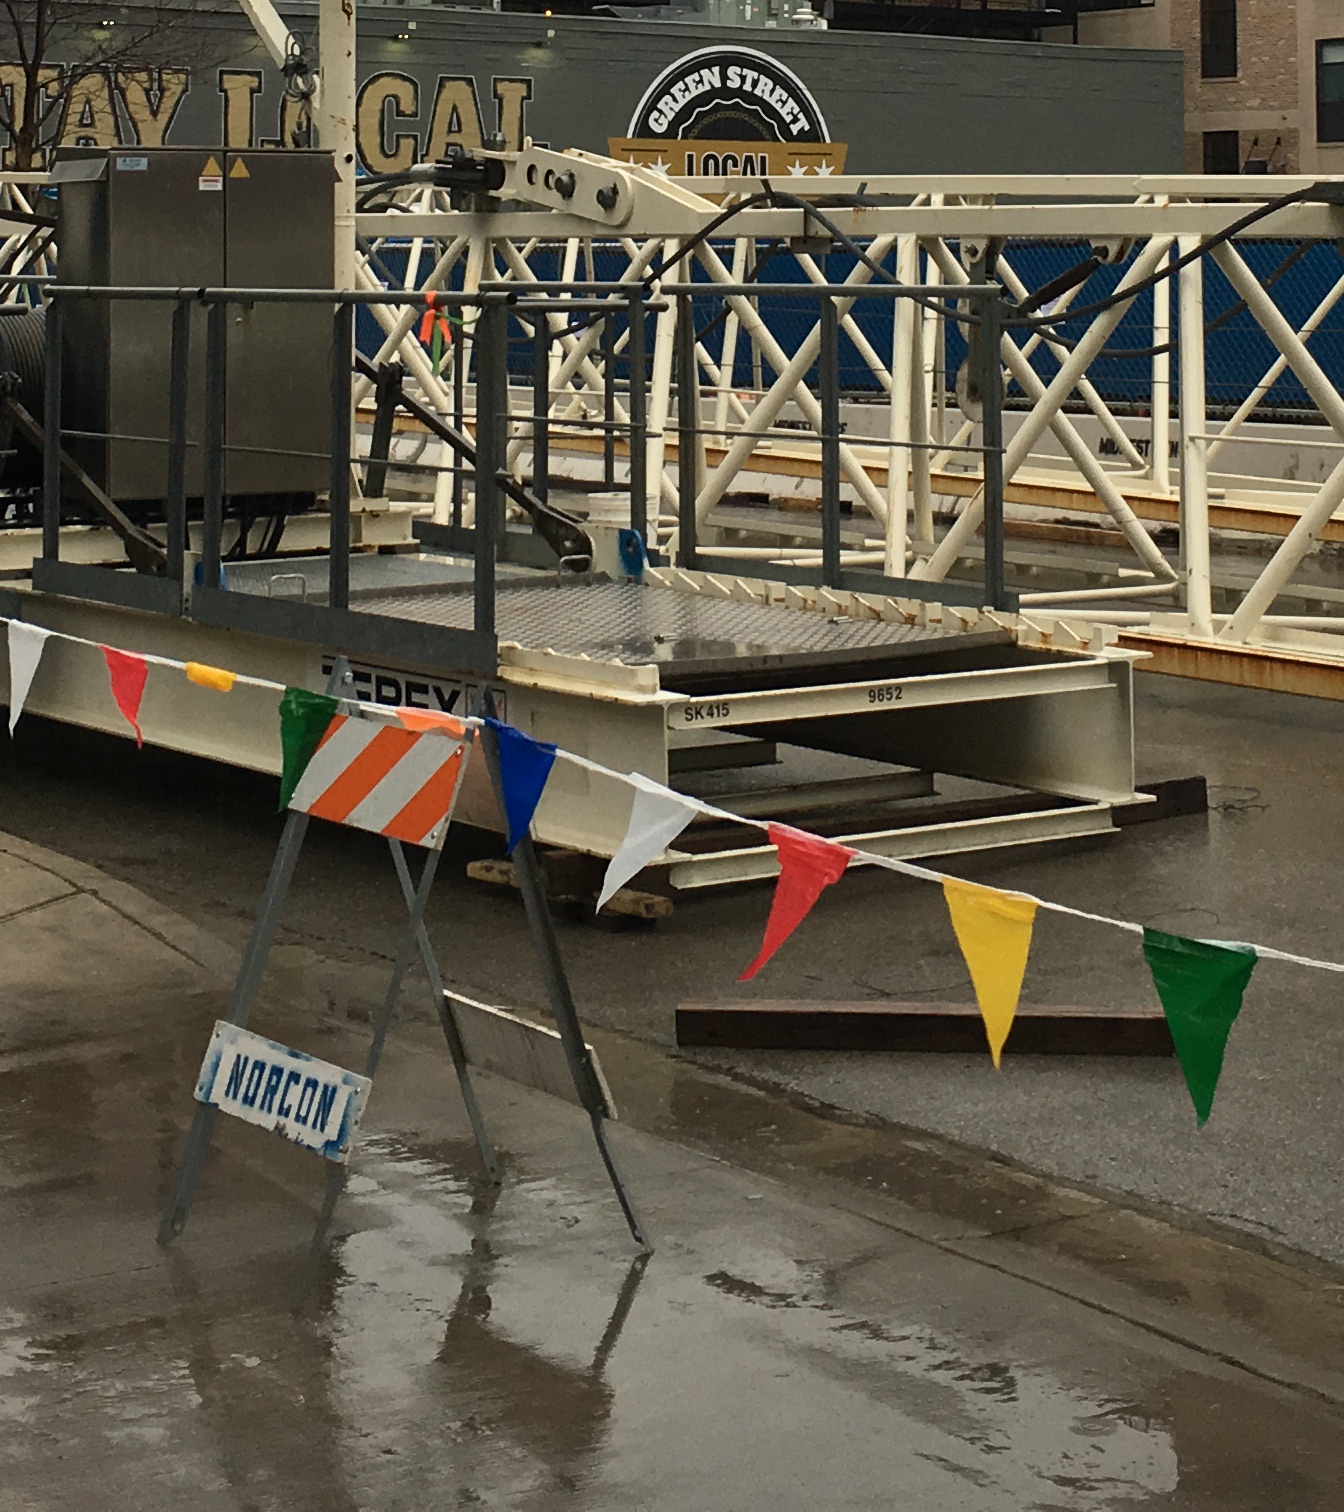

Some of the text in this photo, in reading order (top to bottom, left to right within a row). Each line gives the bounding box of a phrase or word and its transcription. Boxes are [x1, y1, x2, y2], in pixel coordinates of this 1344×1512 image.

[648, 65, 811, 136] GREEN STREET
[868, 687, 903, 704] 9652
[224, 1053, 338, 1134] NORCON
